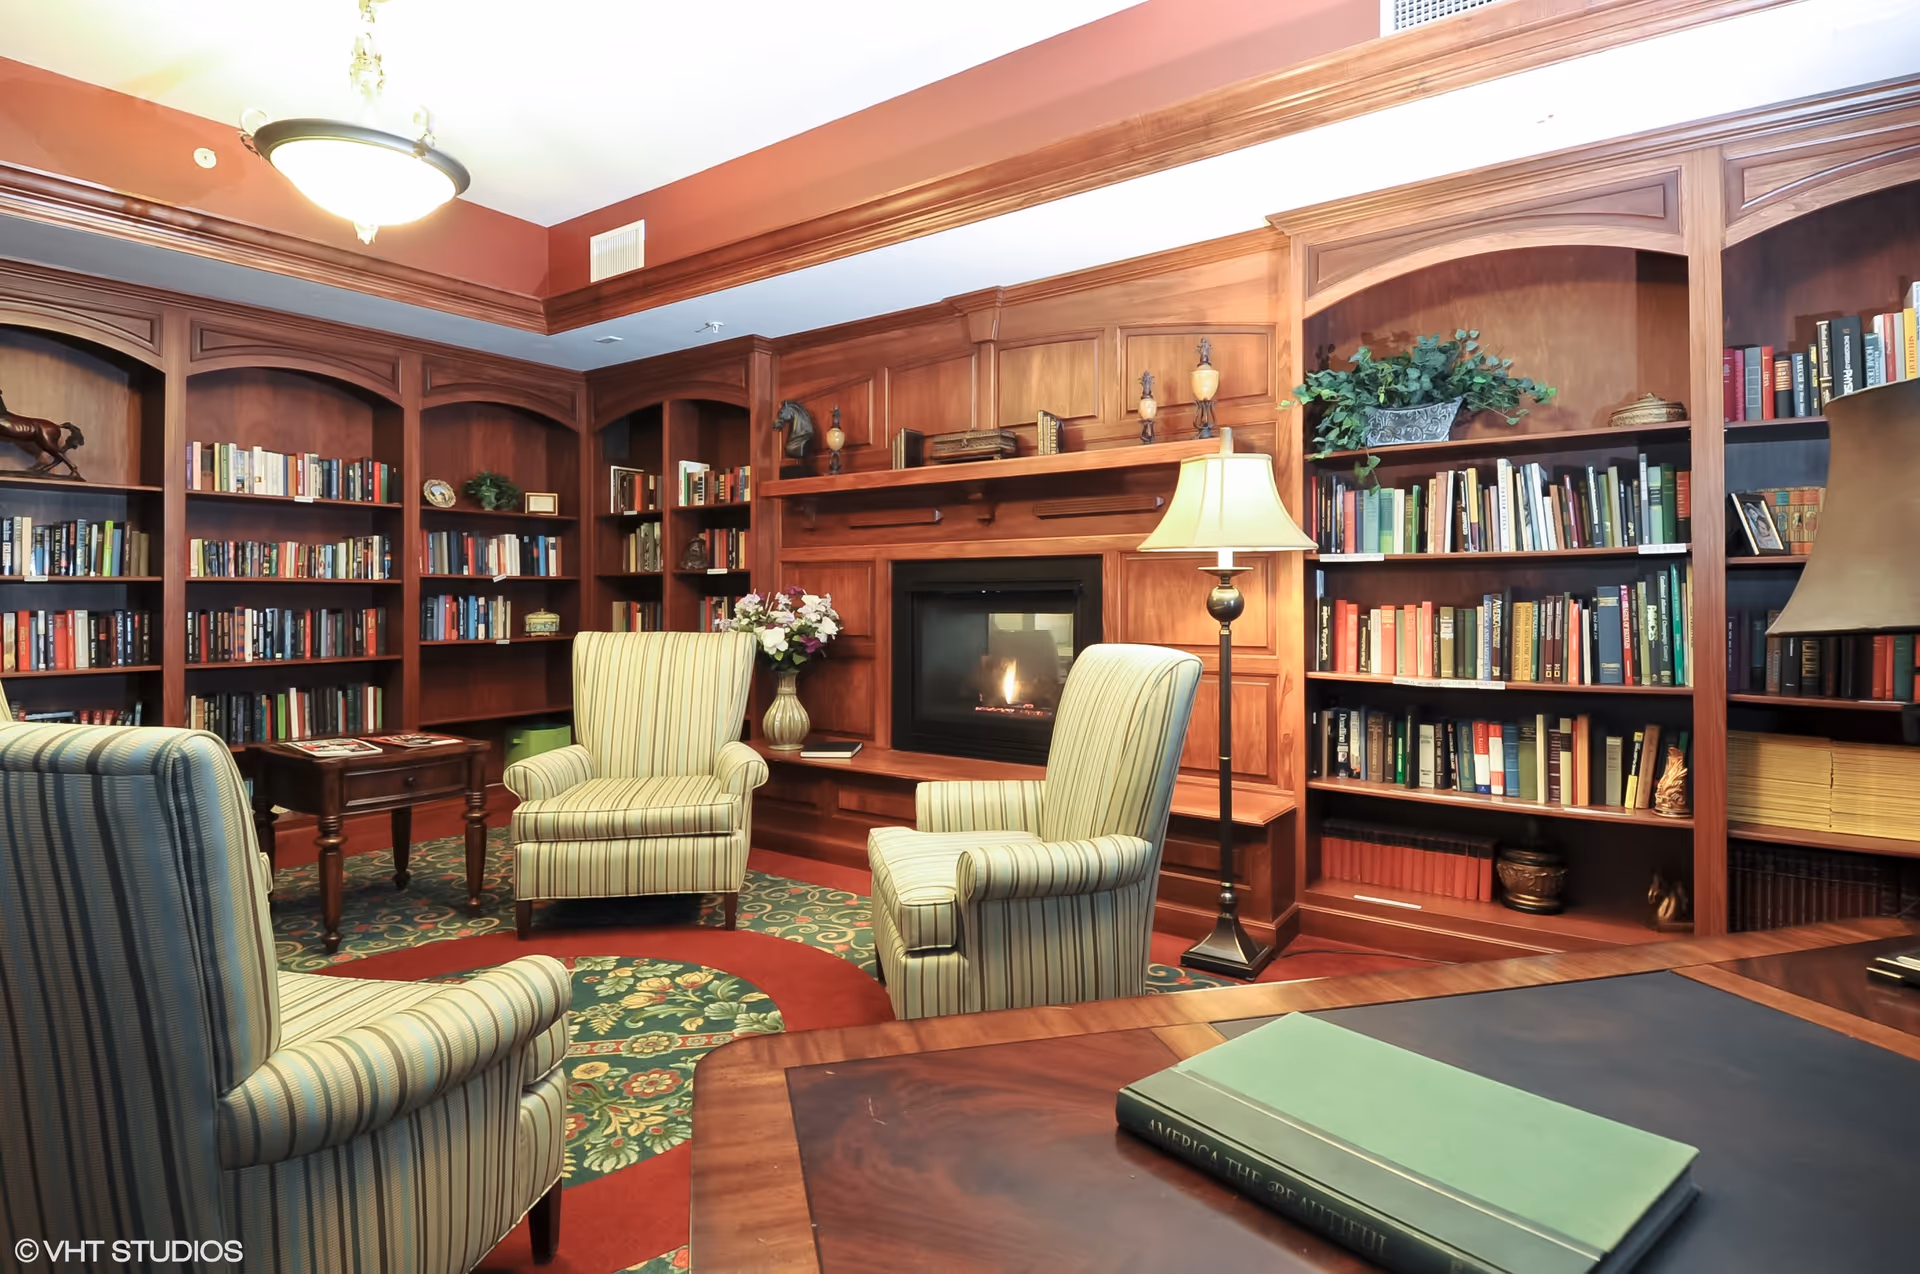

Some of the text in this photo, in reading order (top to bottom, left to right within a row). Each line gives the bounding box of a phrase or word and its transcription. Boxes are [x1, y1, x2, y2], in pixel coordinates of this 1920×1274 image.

[1338, 713, 1347, 743] Deadline
[1147, 1118, 1391, 1258] AMERICA THE BEAUTIFUL
